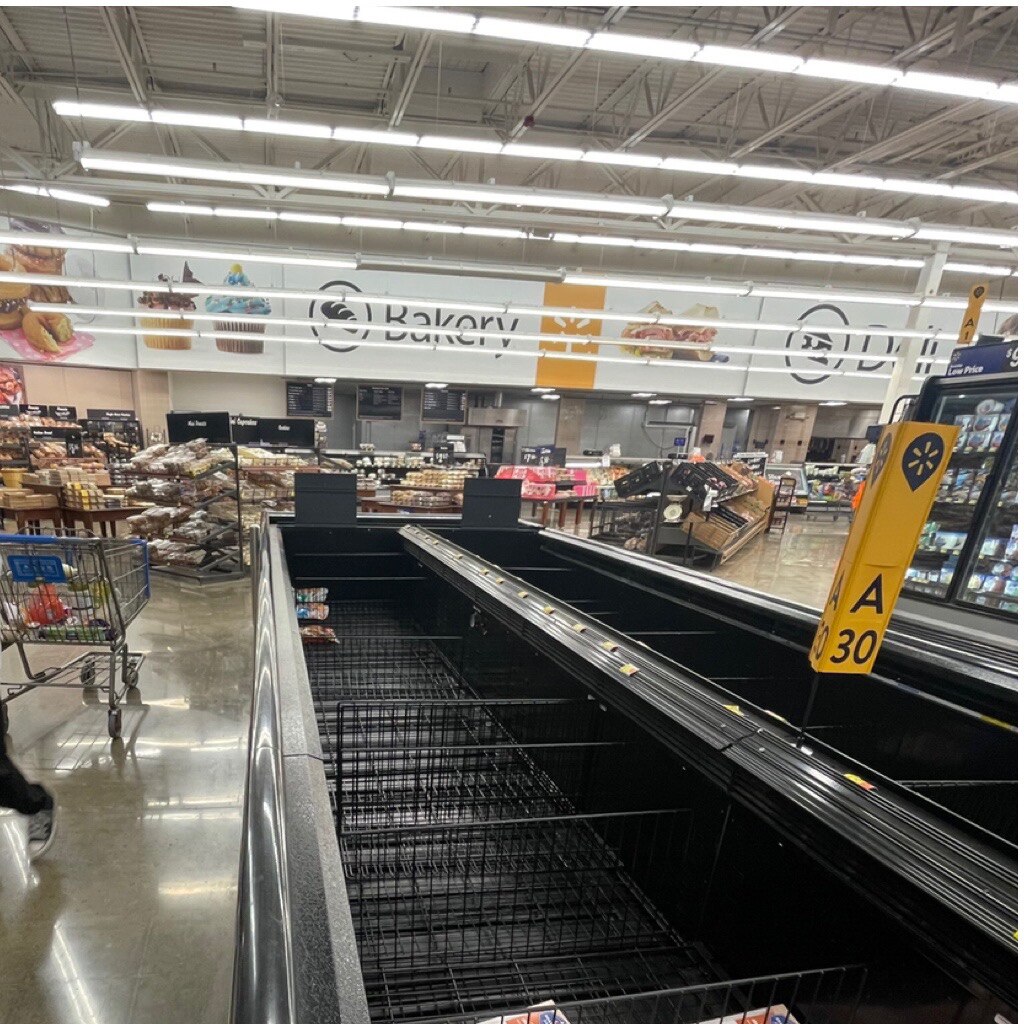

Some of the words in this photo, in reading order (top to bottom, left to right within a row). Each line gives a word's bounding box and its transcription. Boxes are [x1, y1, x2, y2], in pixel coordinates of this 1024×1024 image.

[385, 303, 519, 358] Bakery
[964, 318, 974, 328] A
[857, 325, 938, 374] Dli
[947, 367, 963, 375] Low
[964, 365, 984, 374] Price
[850, 573, 883, 614] A
[829, 628, 878, 665] 30
